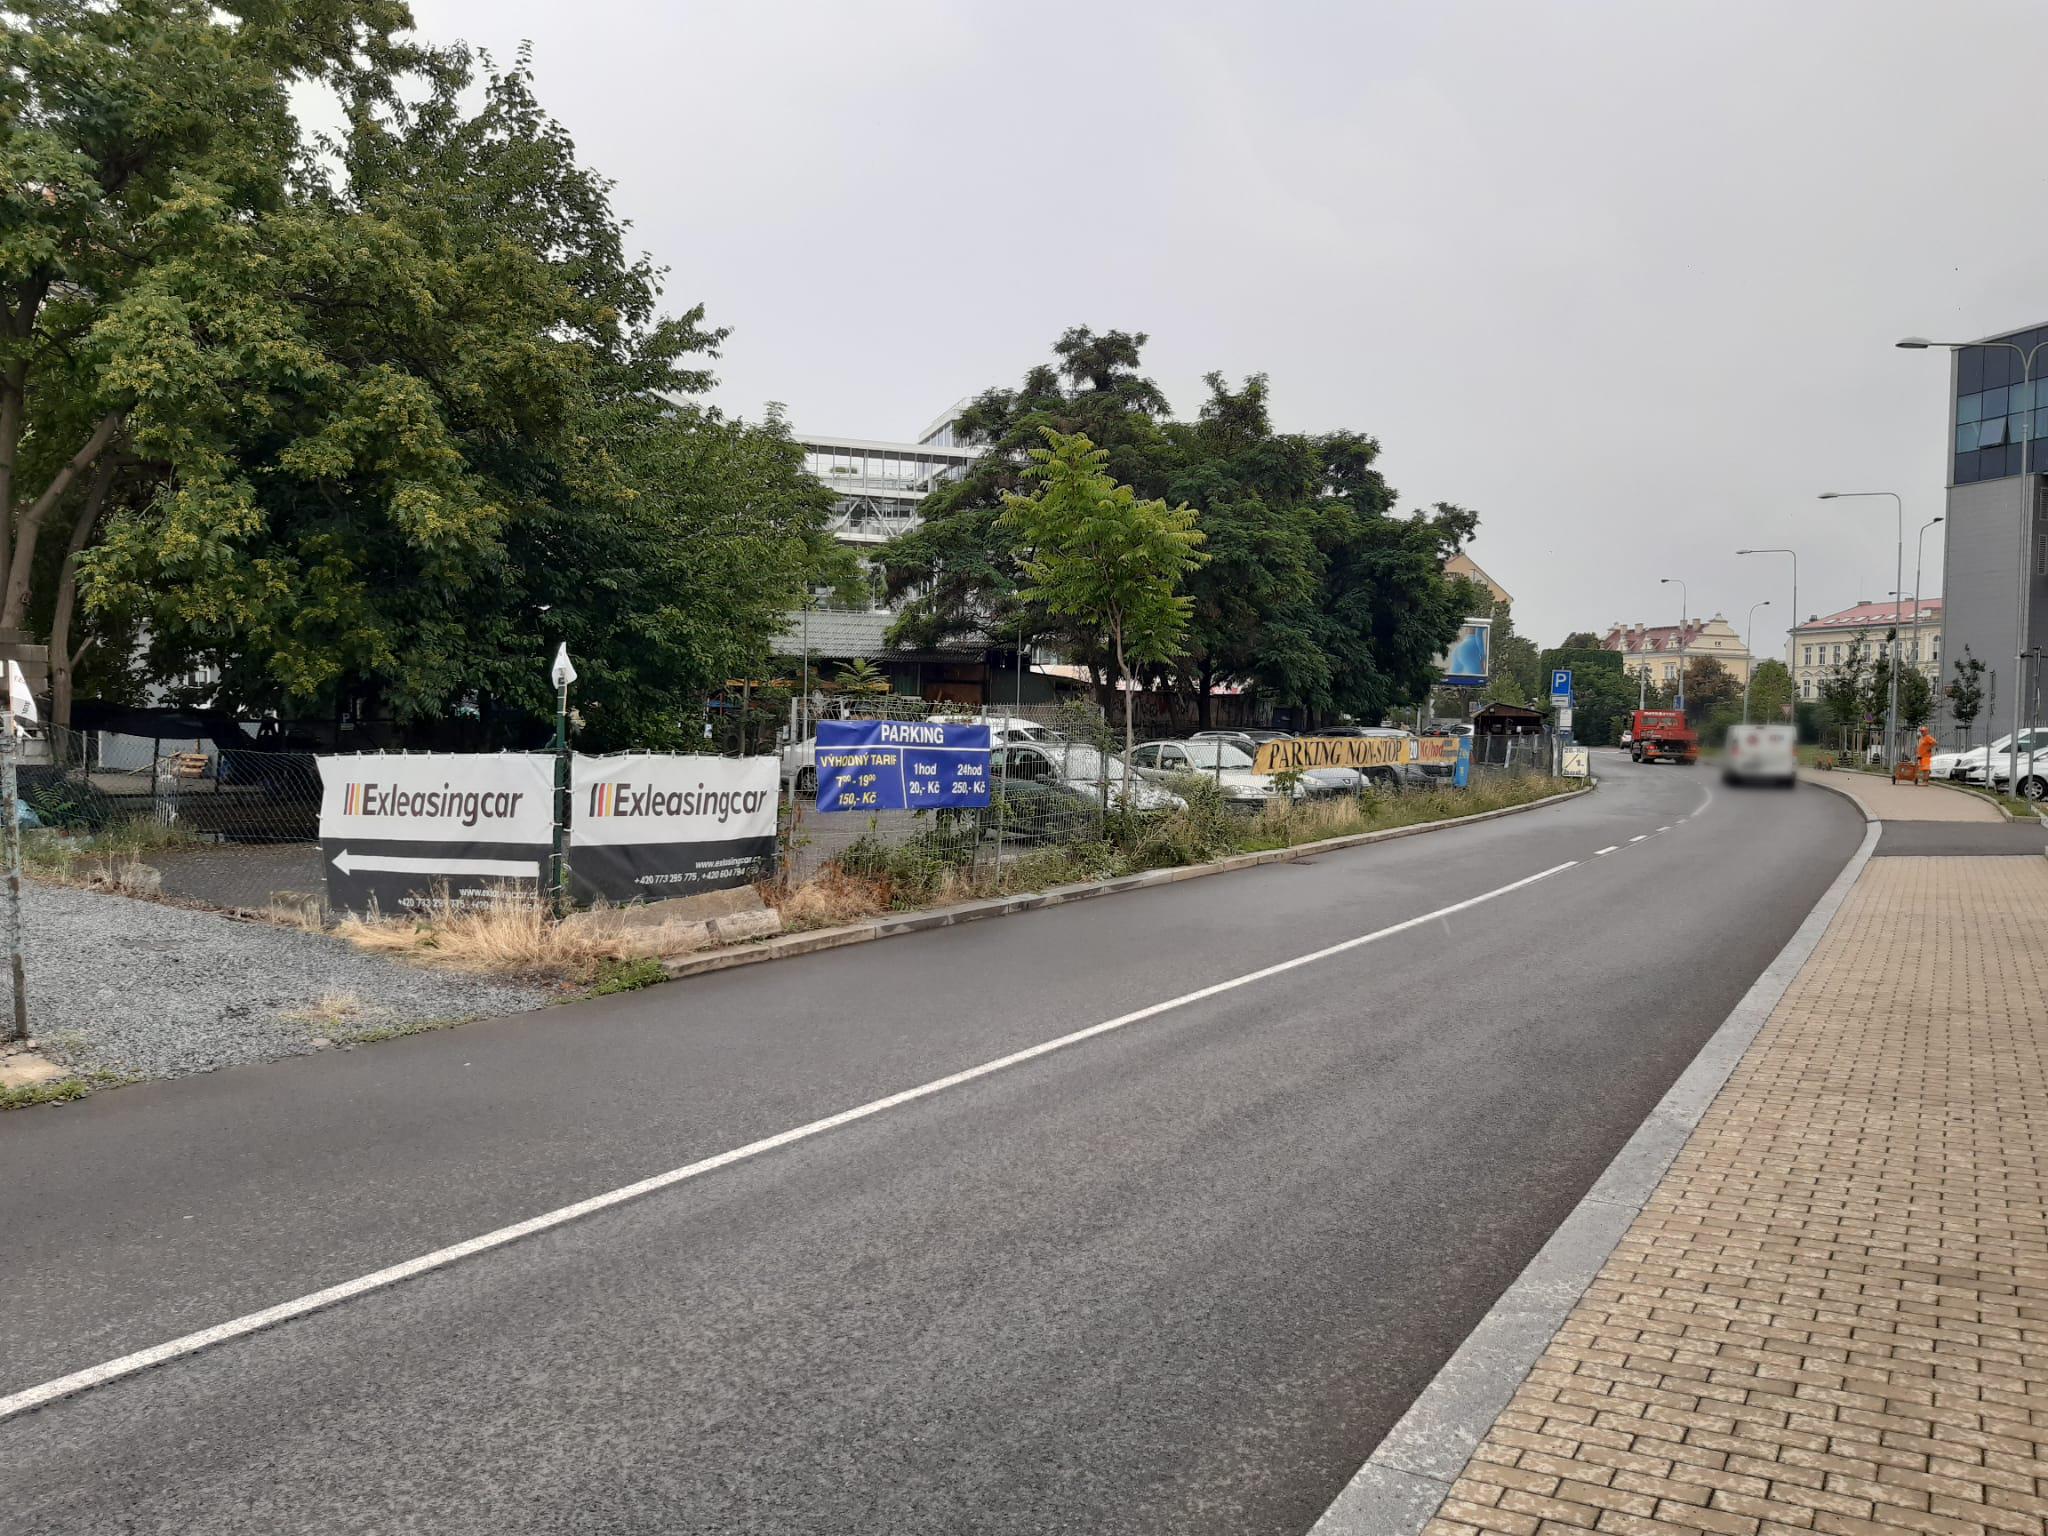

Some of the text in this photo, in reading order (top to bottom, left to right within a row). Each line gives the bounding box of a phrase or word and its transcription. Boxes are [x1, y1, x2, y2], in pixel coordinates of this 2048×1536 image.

[1555, 673, 1567, 688] P
[881, 724, 944, 744] PARKING
[820, 752, 897, 768] VÝHODNÝ TARIF
[1268, 739, 1402, 770] PARKING NON-STOP
[956, 763, 983, 776] 24hod
[927, 781, 940, 794] Kč
[973, 780, 986, 794] Kč
[361, 782, 524, 827] Exleasingcar
[613, 782, 768, 824] Exleasingcar
[862, 791, 878, 805] Kč
